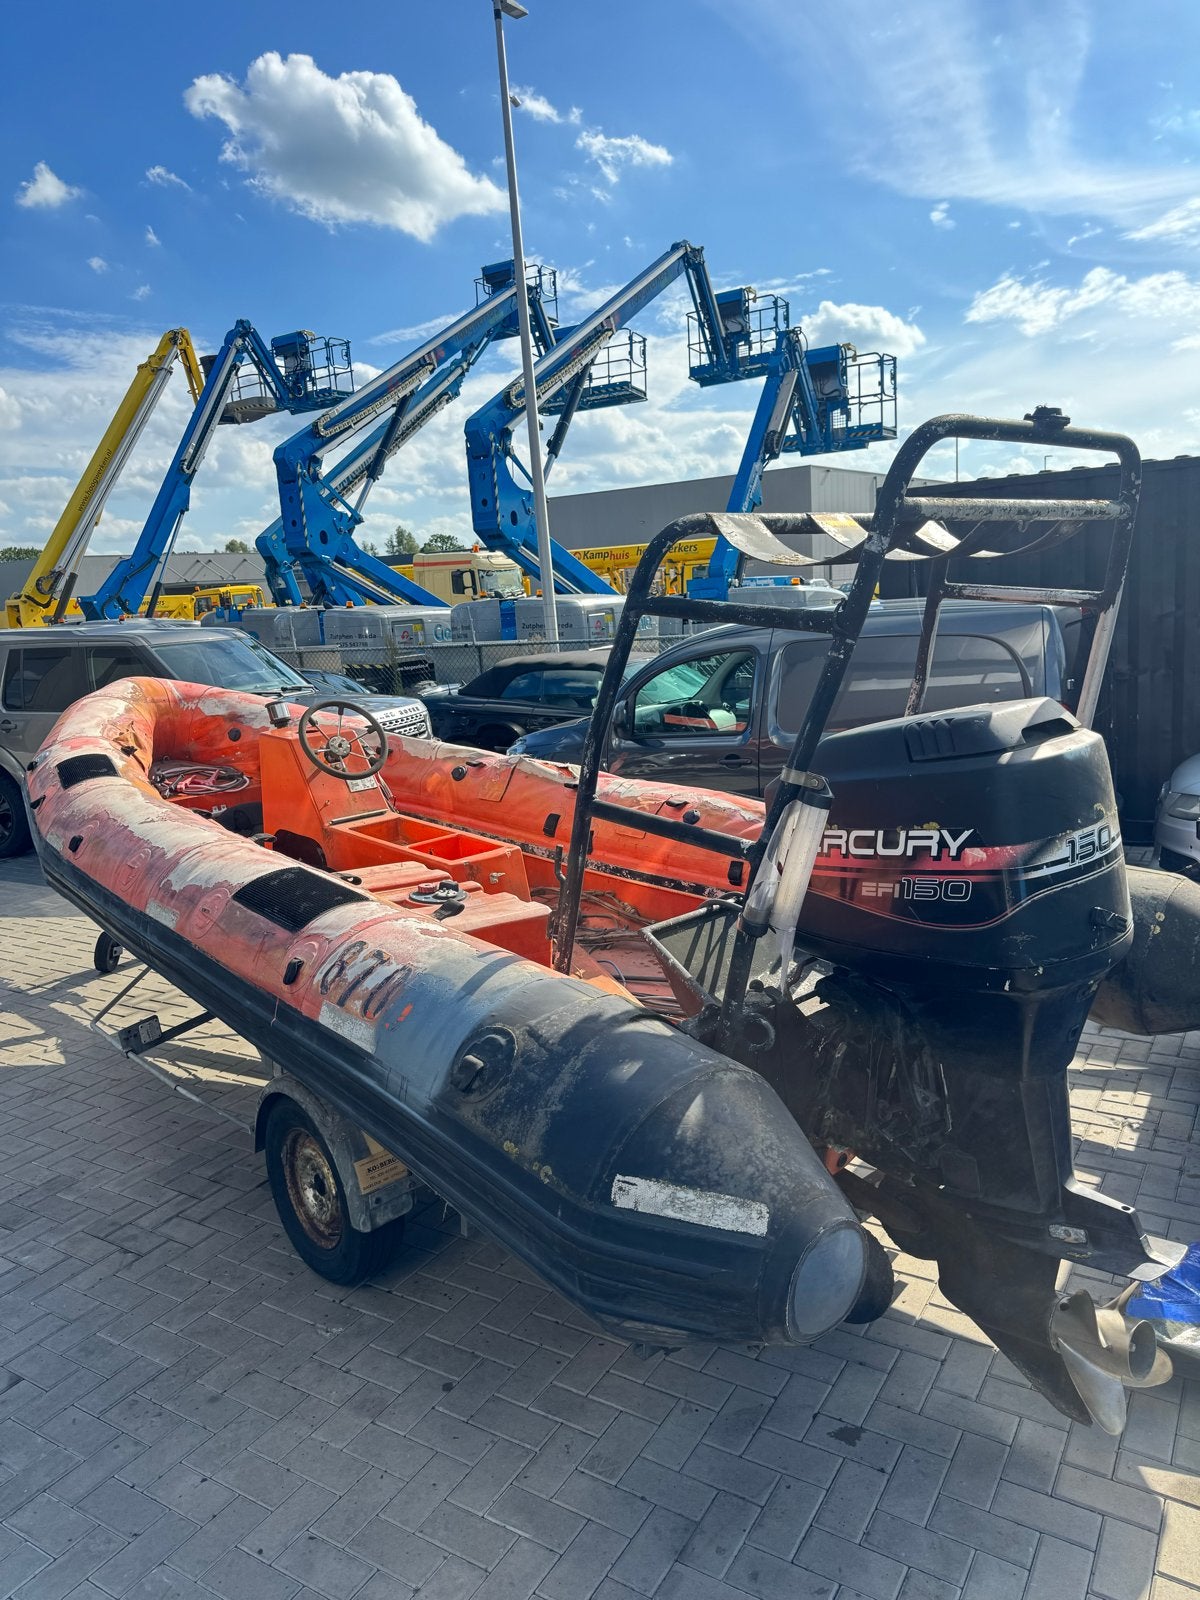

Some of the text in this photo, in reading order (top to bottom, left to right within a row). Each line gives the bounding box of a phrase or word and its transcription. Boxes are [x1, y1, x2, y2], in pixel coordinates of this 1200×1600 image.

[583, 550, 630, 562] Kamphuis
[817, 828, 975, 859] RCURY
[1066, 824, 1111, 867] 150
[861, 877, 972, 902] EFI 150
